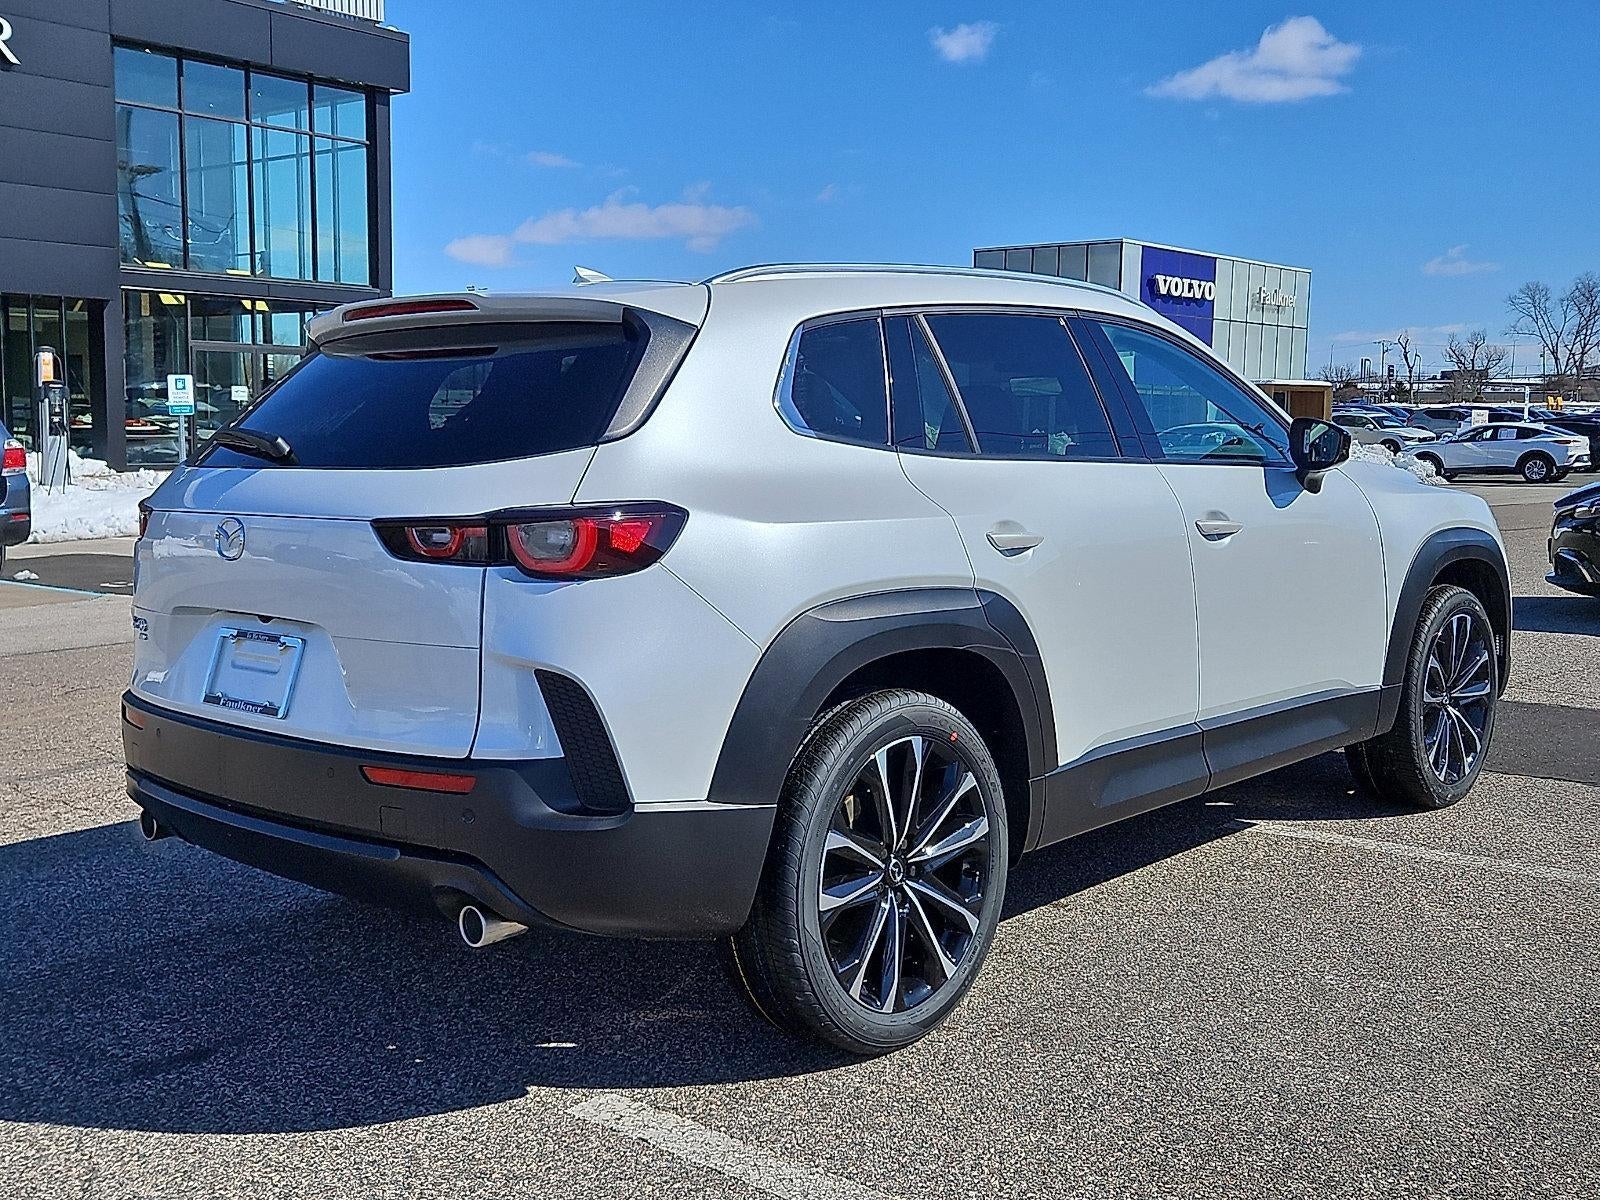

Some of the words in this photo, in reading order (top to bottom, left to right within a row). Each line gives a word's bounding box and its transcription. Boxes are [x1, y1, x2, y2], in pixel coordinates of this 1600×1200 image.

[1155, 274, 1216, 301] VOLVO
[1260, 286, 1296, 308] Faulkner
[219, 697, 264, 714] Faulkner
